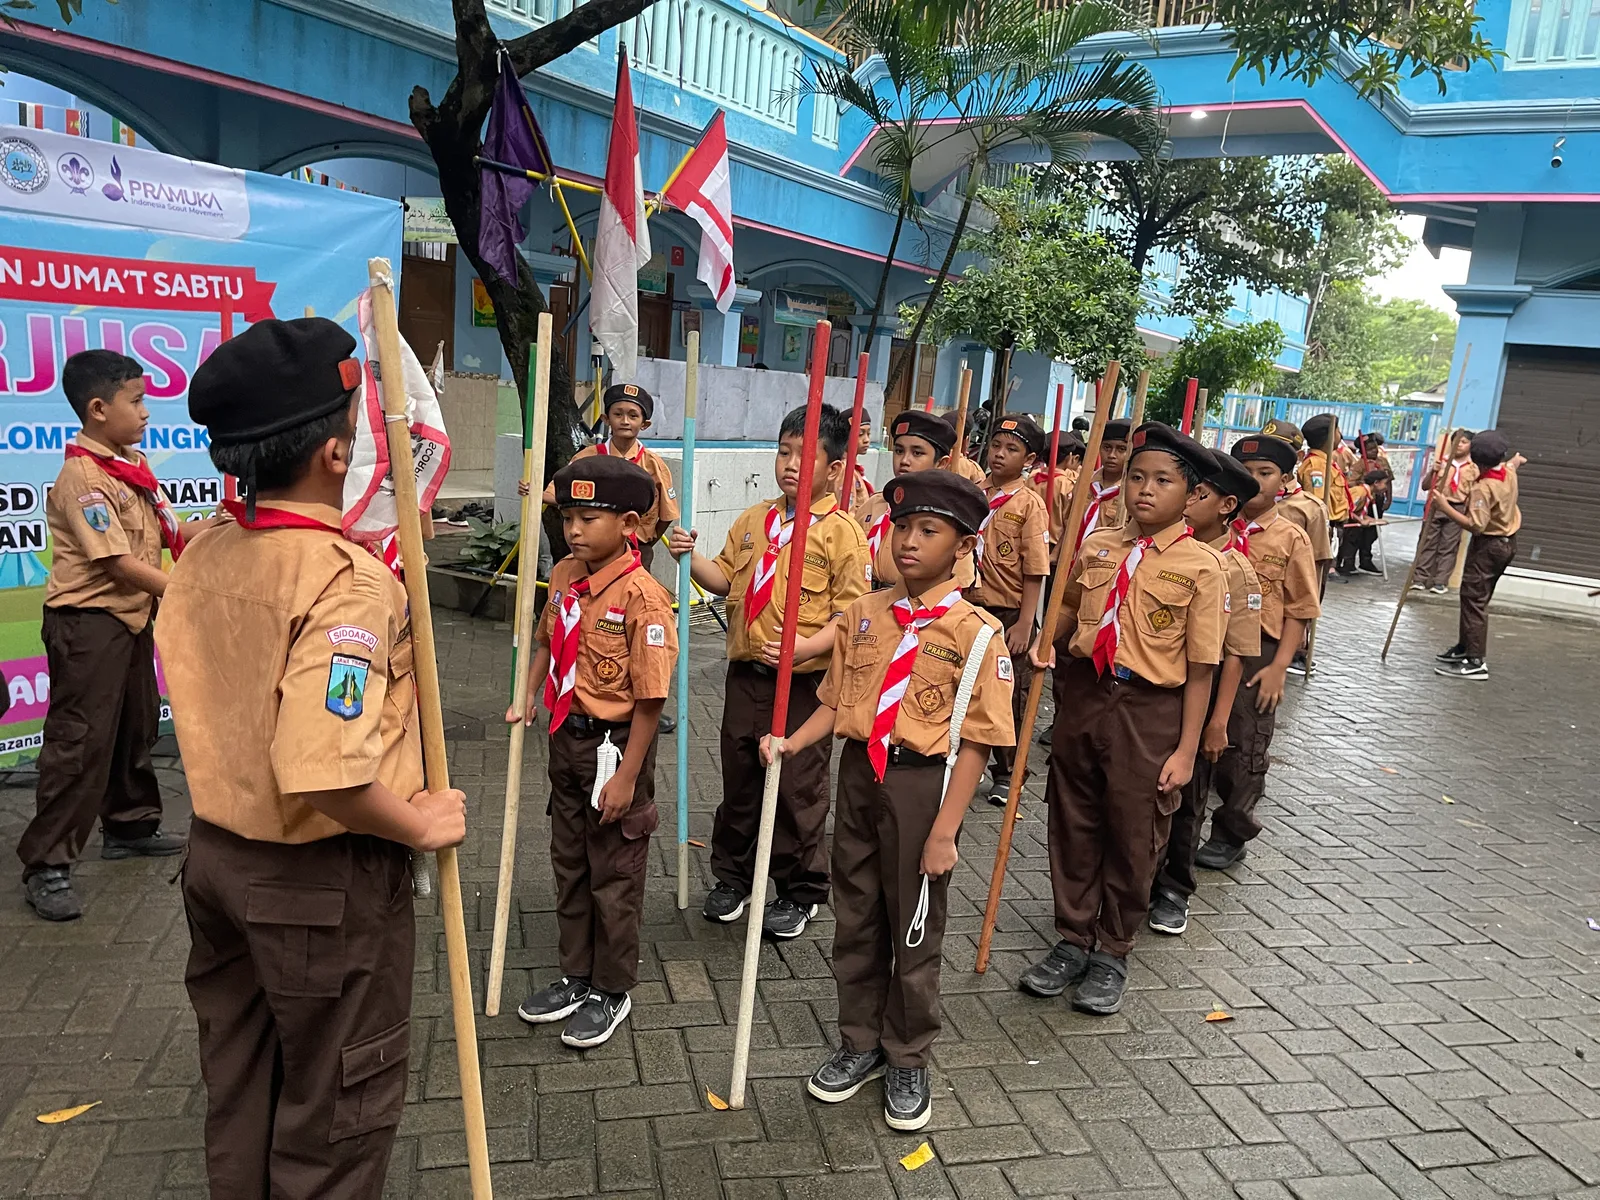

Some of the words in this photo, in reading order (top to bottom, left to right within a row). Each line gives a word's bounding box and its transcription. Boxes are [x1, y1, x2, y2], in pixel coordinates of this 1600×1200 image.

[129, 180, 223, 211] PRAMUKA
[131, 198, 166, 209] Indonesia
[167, 203, 187, 213] Scout
[189, 207, 224, 219] Movement
[30, 262, 147, 294] JUMA'T
[155, 271, 243, 300] SABTU
[0, 314, 223, 399] JUS
[805, 553, 826, 567] AMUKA
[1160, 571, 1192, 587] PRAMUKA
[333, 629, 375, 645] SIDOARJO
